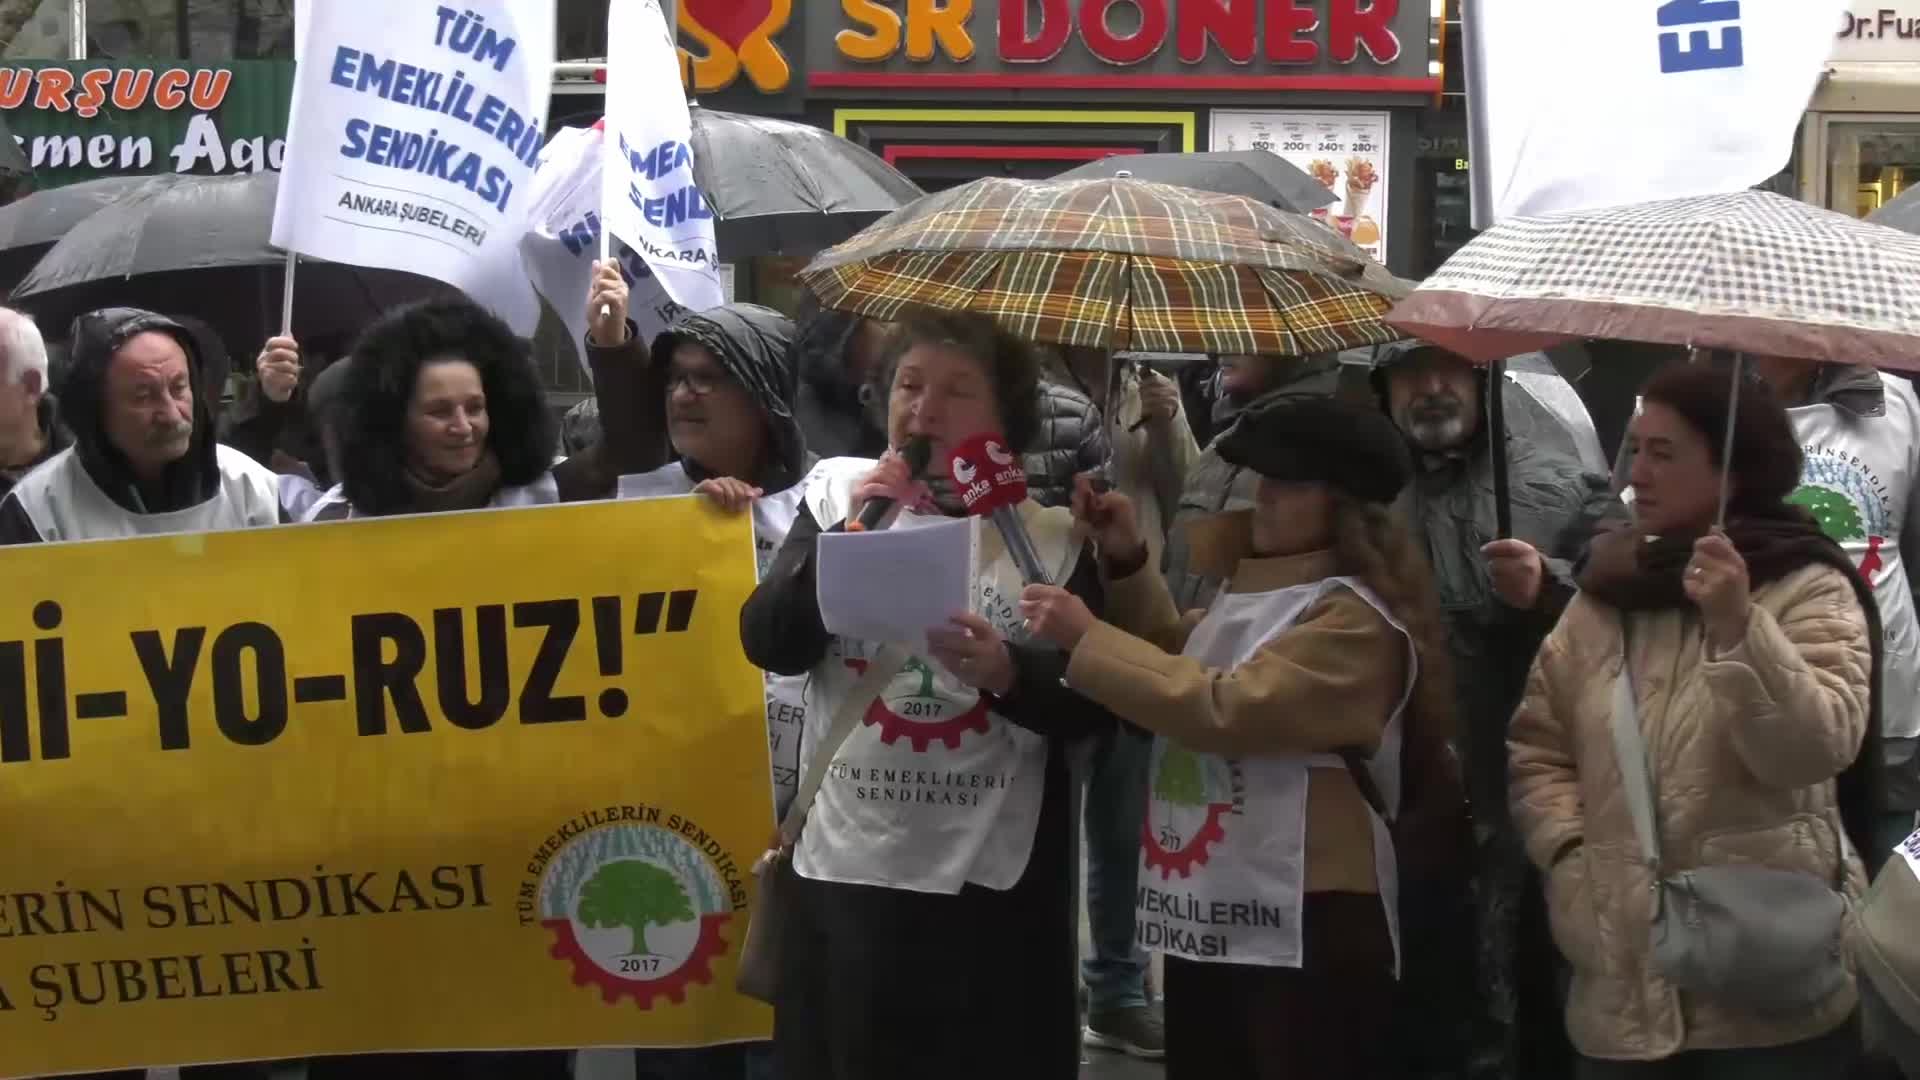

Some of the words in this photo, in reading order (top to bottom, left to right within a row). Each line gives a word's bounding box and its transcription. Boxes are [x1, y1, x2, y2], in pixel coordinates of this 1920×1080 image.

[435, 5, 516, 72] TÜM
[835, 0, 976, 62] SR
[340, 118, 513, 213] SENDİKASI
[338, 191, 398, 217] ANKARA
[399, 202, 487, 247] ŞUBELERİ
[903, 701, 942, 717] 2017
[143, 864, 491, 928] SENDİKASI
[517, 881, 536, 927] TÜM
[527, 803, 662, 877] EMEKLİLERİN
[667, 814, 748, 911] SENDİKASI
[29, 937, 324, 1022] ŞUBELERİ
[620, 959, 660, 973] 2017
